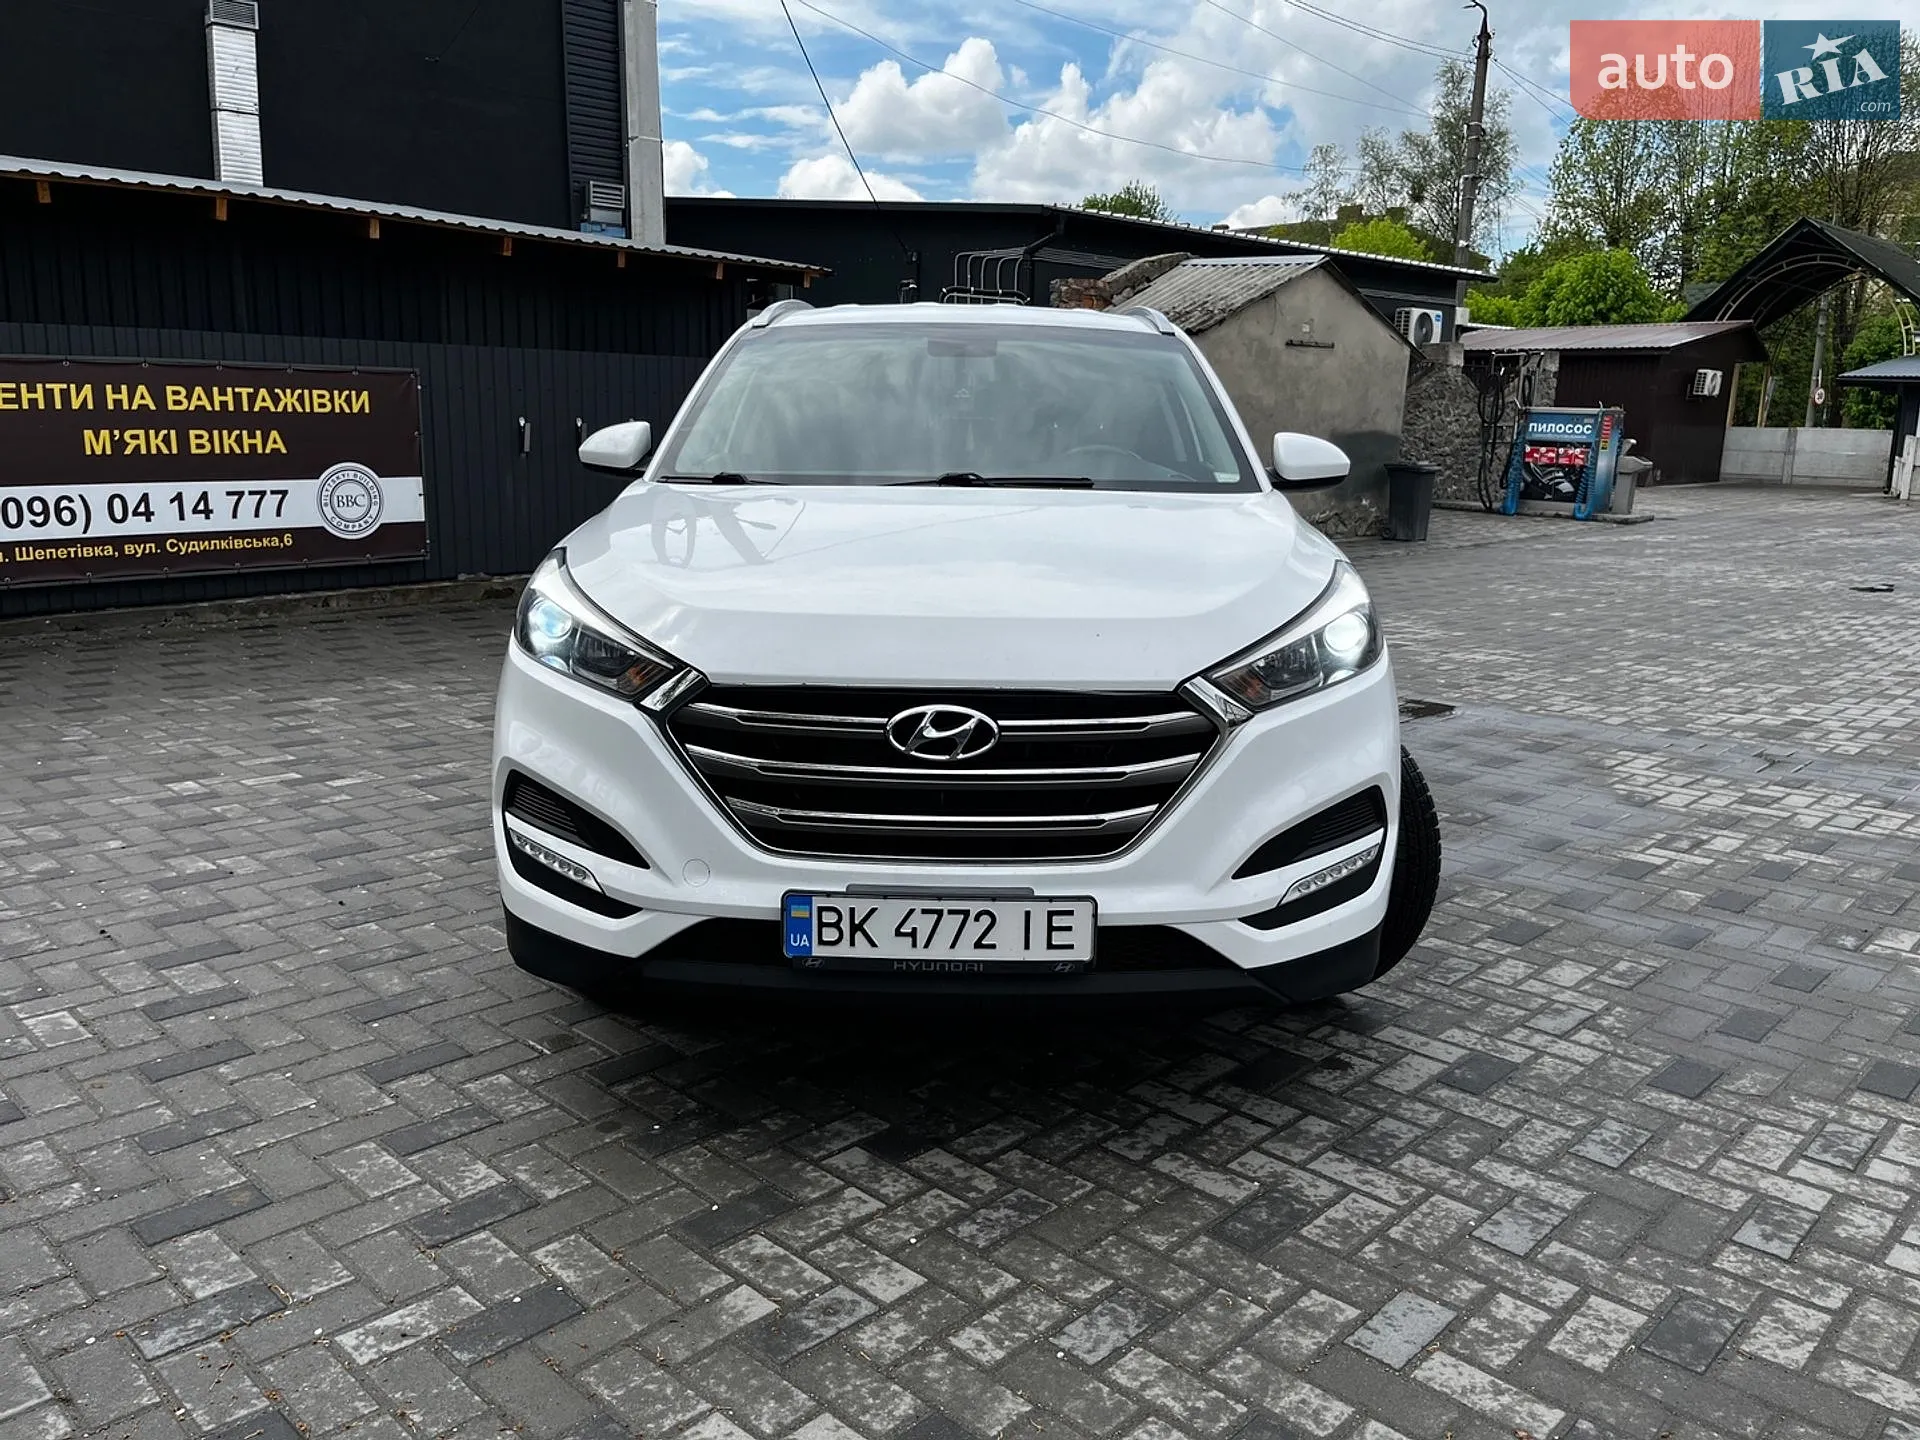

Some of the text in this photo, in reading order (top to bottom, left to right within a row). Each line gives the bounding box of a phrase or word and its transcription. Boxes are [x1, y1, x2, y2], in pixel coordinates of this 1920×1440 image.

[105, 384, 156, 411] НА
[165, 385, 370, 414] ВАНТАЖІВКИ
[189, 430, 288, 454] ВІКНА
[107, 492, 155, 524] 04
[169, 490, 214, 522] 14
[225, 489, 290, 520] 777
[336, 493, 366, 508] BBC
[330, 514, 373, 529] COMPANY
[15, 544, 119, 562] Шепетівка,
[124, 542, 161, 557] вул.
[816, 905, 879, 948] BK
[894, 908, 997, 949] 4772
[790, 933, 810, 948] UA
[893, 962, 984, 972] HYUNDAI
